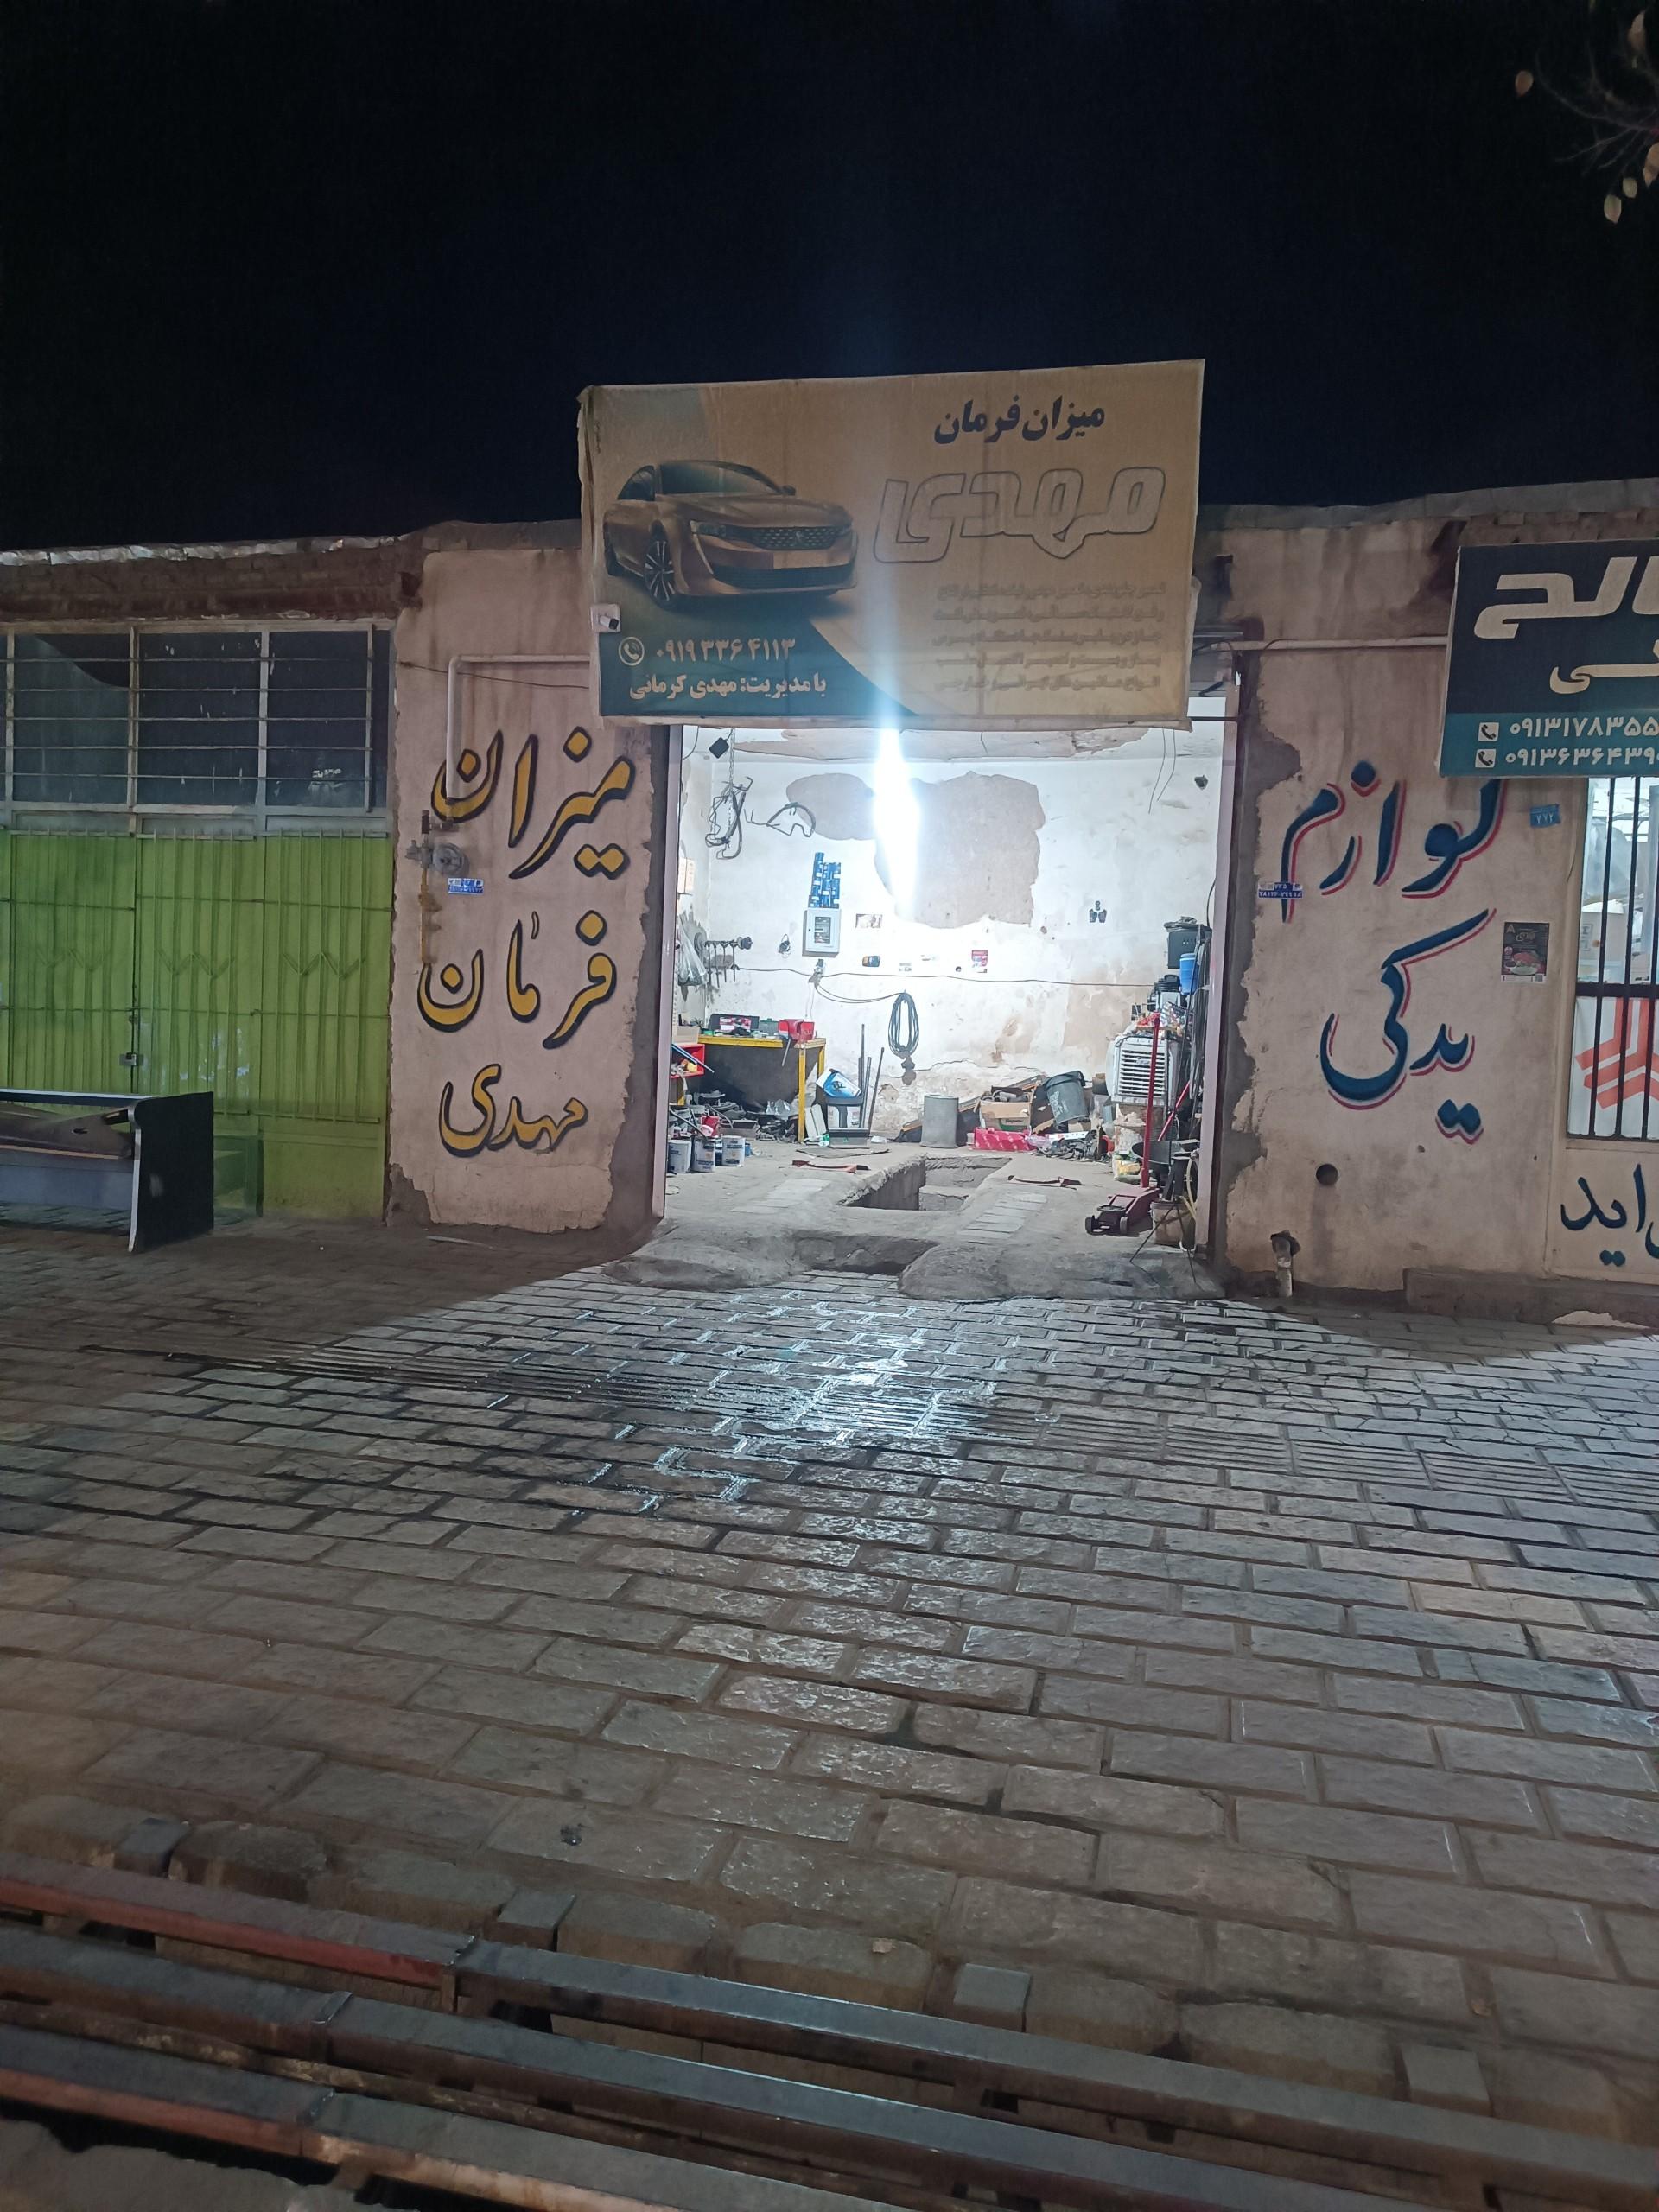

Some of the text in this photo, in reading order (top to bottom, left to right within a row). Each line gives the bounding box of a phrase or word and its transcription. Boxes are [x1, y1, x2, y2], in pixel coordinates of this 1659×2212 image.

[933, 394, 1105, 445] میزان فرمان
[873, 467, 1166, 563] مهدی
[1473, 555, 1659, 639] الح
[629, 673, 688, 700] کرمانی
[690, 677, 737, 700] مهدی
[430, 726, 637, 880] میزان
[1505, 747, 1659, 766] ۰۹۱۳۶۳۶۴۳۹
[1281, 759, 1508, 924] لوازم
[416, 909, 618, 1050] فرمان
[1319, 907, 1497, 1145] یدکی
[438, 1063, 589, 1158] مهدی
